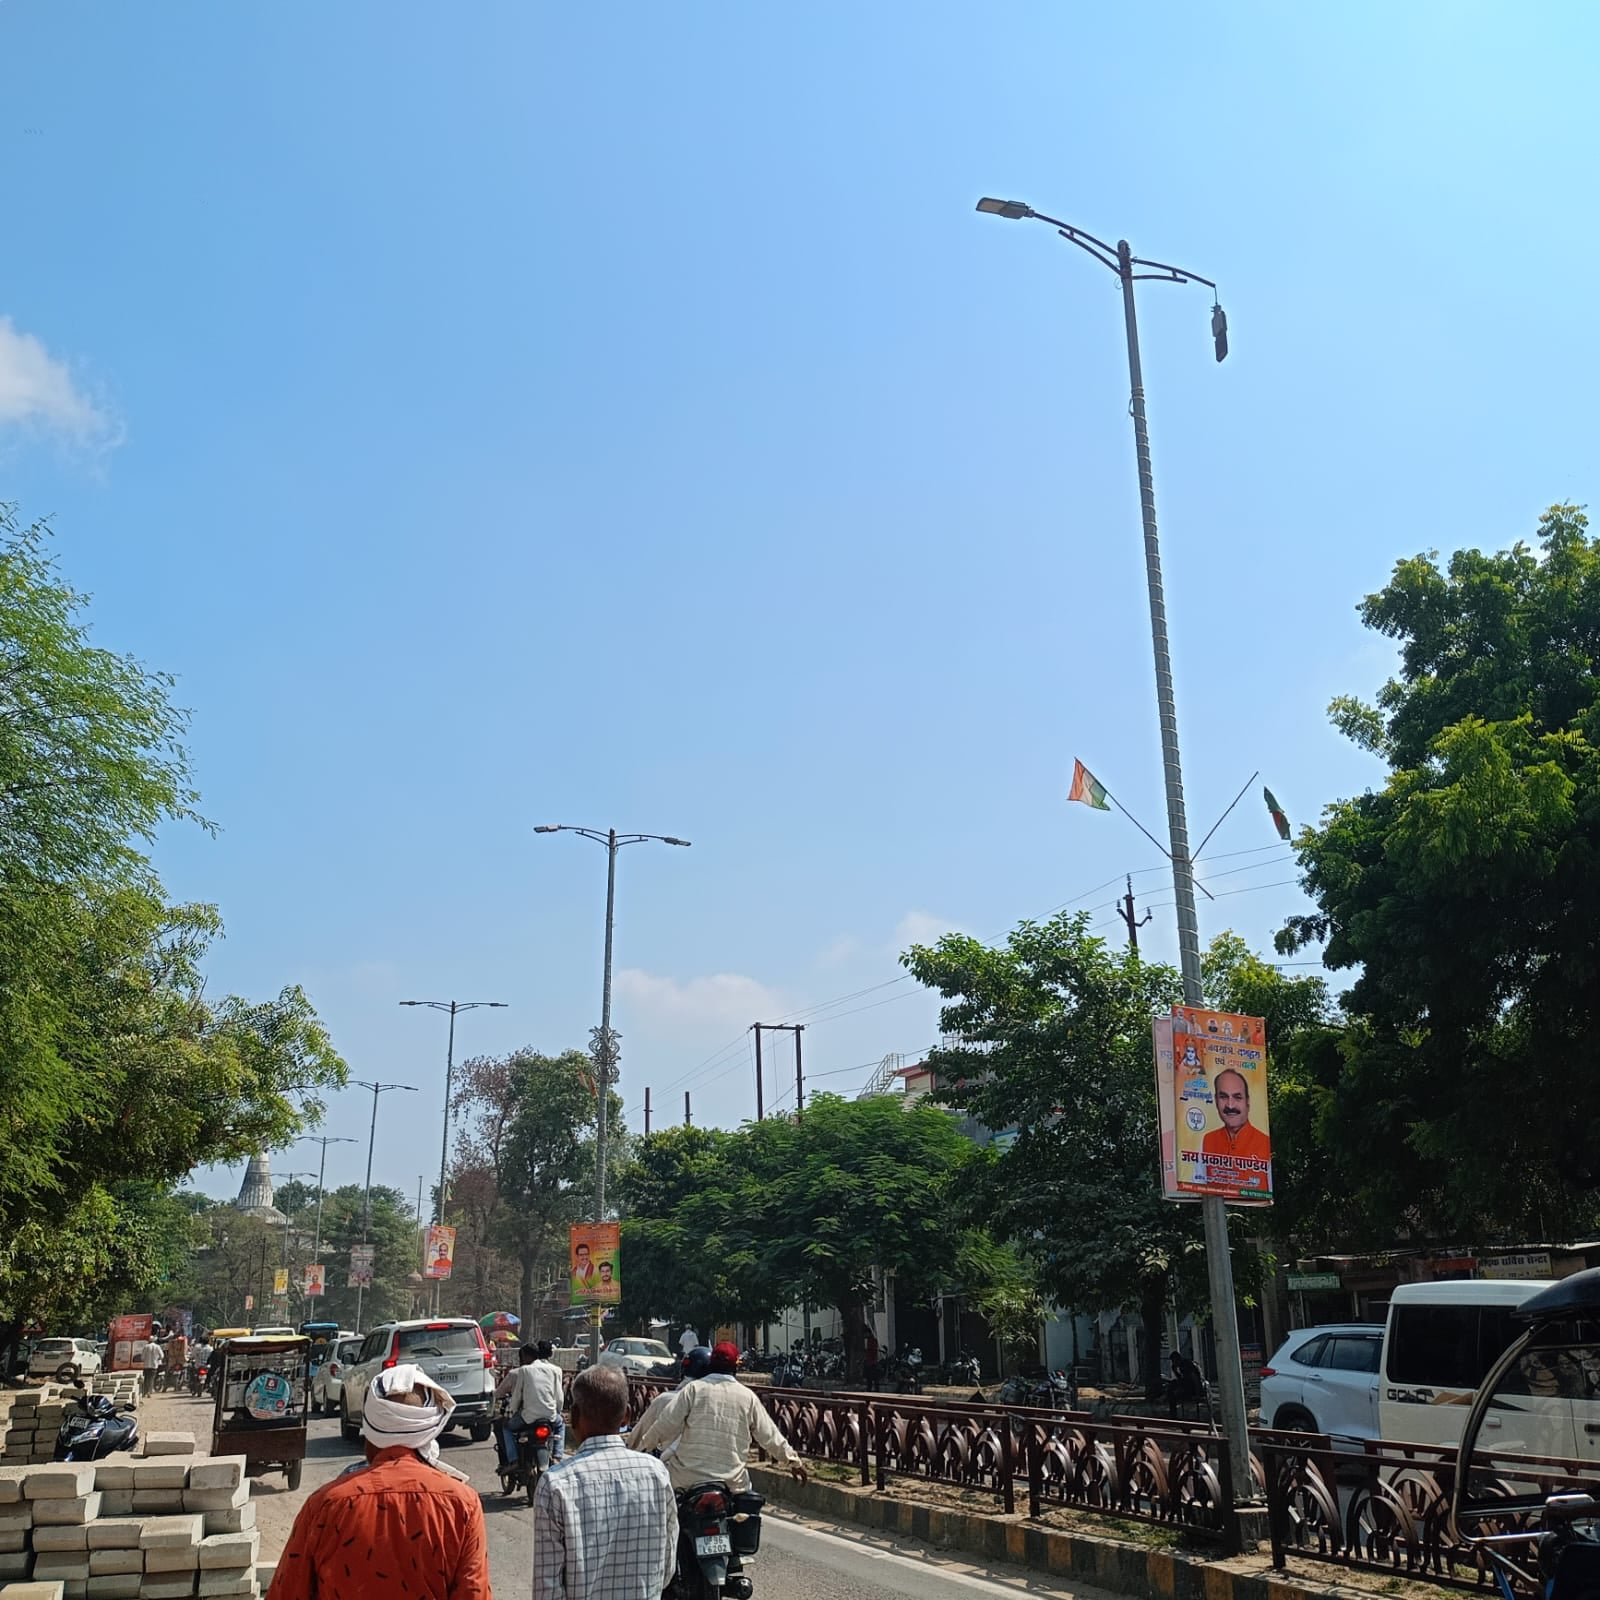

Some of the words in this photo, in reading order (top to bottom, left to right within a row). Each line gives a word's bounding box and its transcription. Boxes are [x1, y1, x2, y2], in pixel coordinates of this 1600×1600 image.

[1181, 1150, 1199, 1163] जय
[1201, 1152, 1233, 1169] प्रकाश
[1234, 1154, 1269, 1173] पाण्डेय
